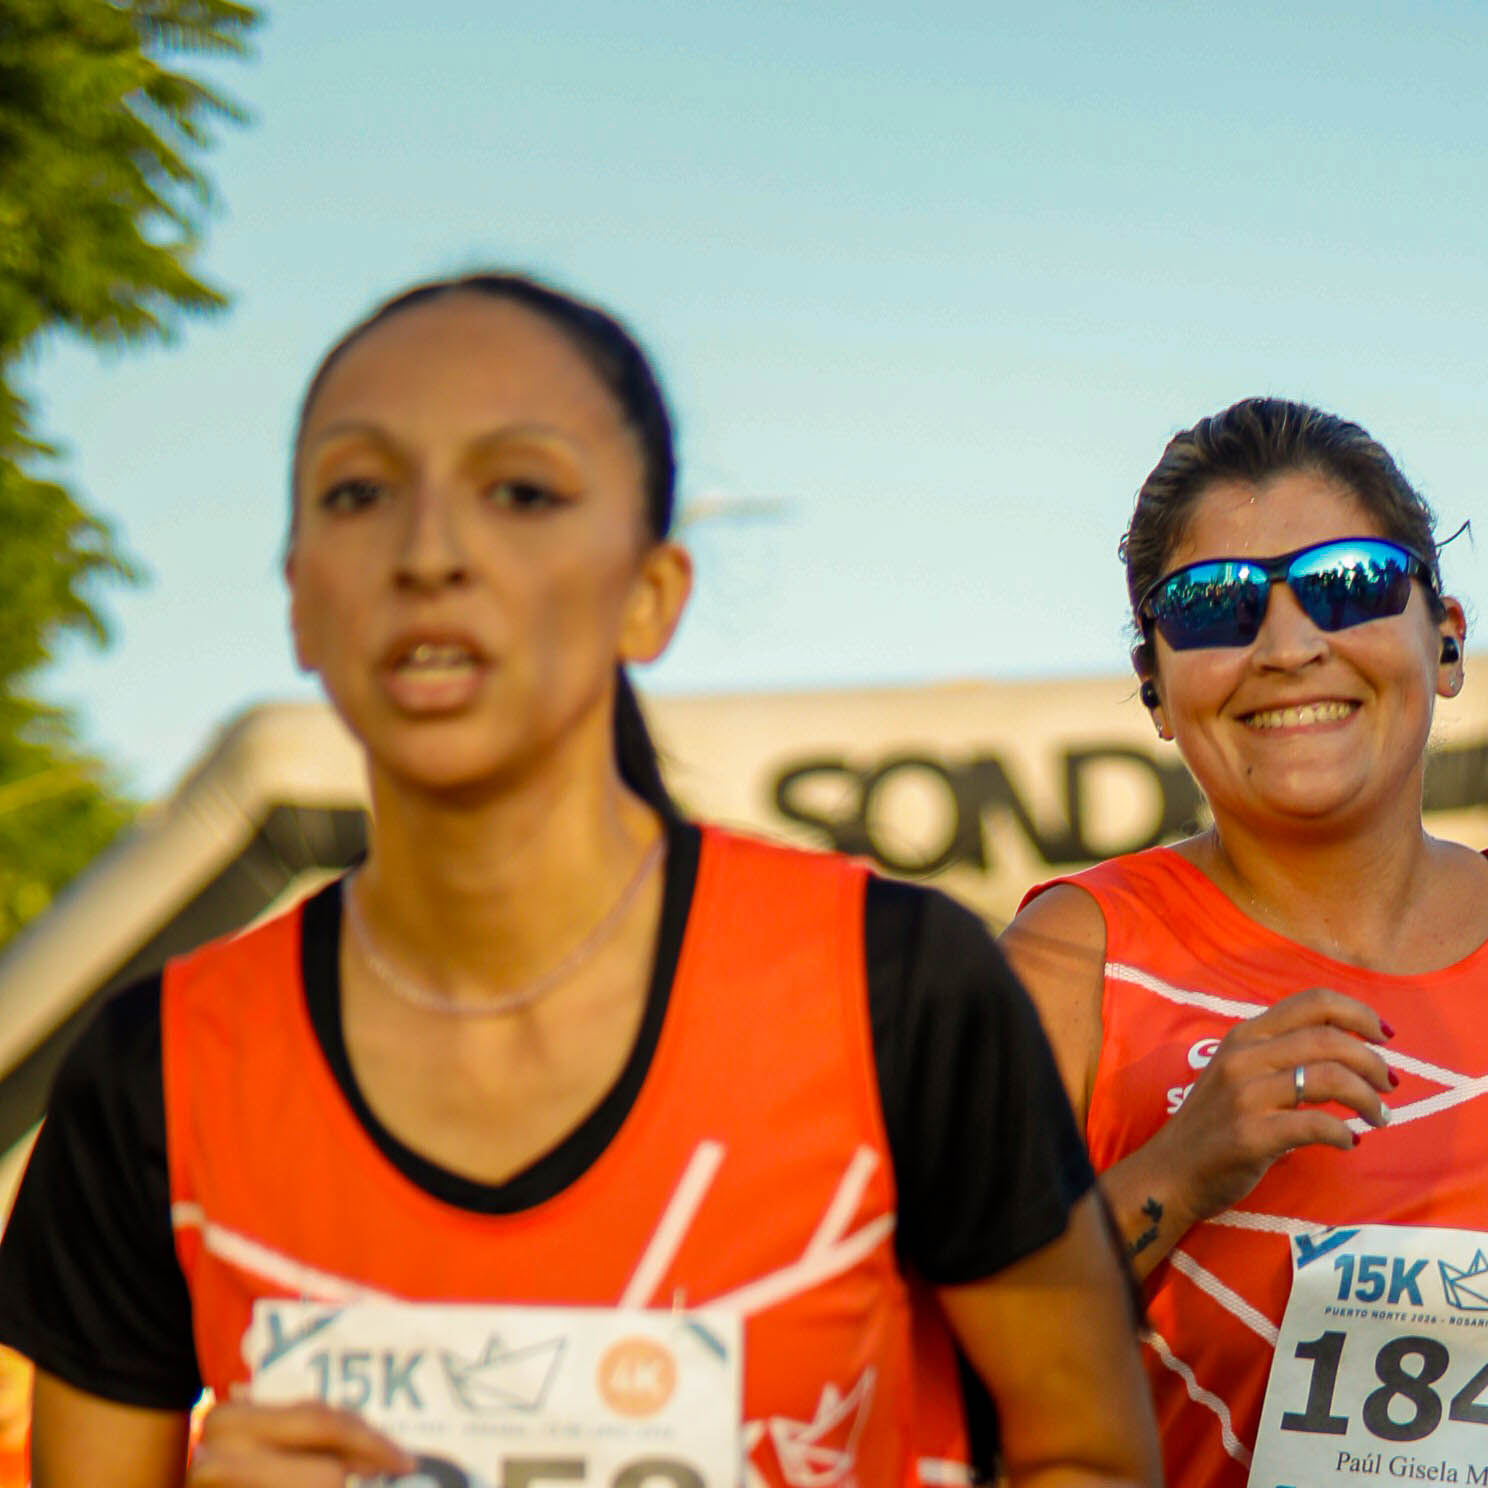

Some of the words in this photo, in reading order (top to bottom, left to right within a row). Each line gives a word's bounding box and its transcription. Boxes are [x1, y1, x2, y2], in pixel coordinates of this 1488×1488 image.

[1333, 1253, 1429, 1306] 15K
[1324, 1305, 1368, 1318] PUERTO
[1371, 1309, 1407, 1321] NORTE
[307, 1351, 430, 1410] 15K
[1336, 1450, 1382, 1475] Paúl
[1388, 1455, 1458, 1483] Gisela
